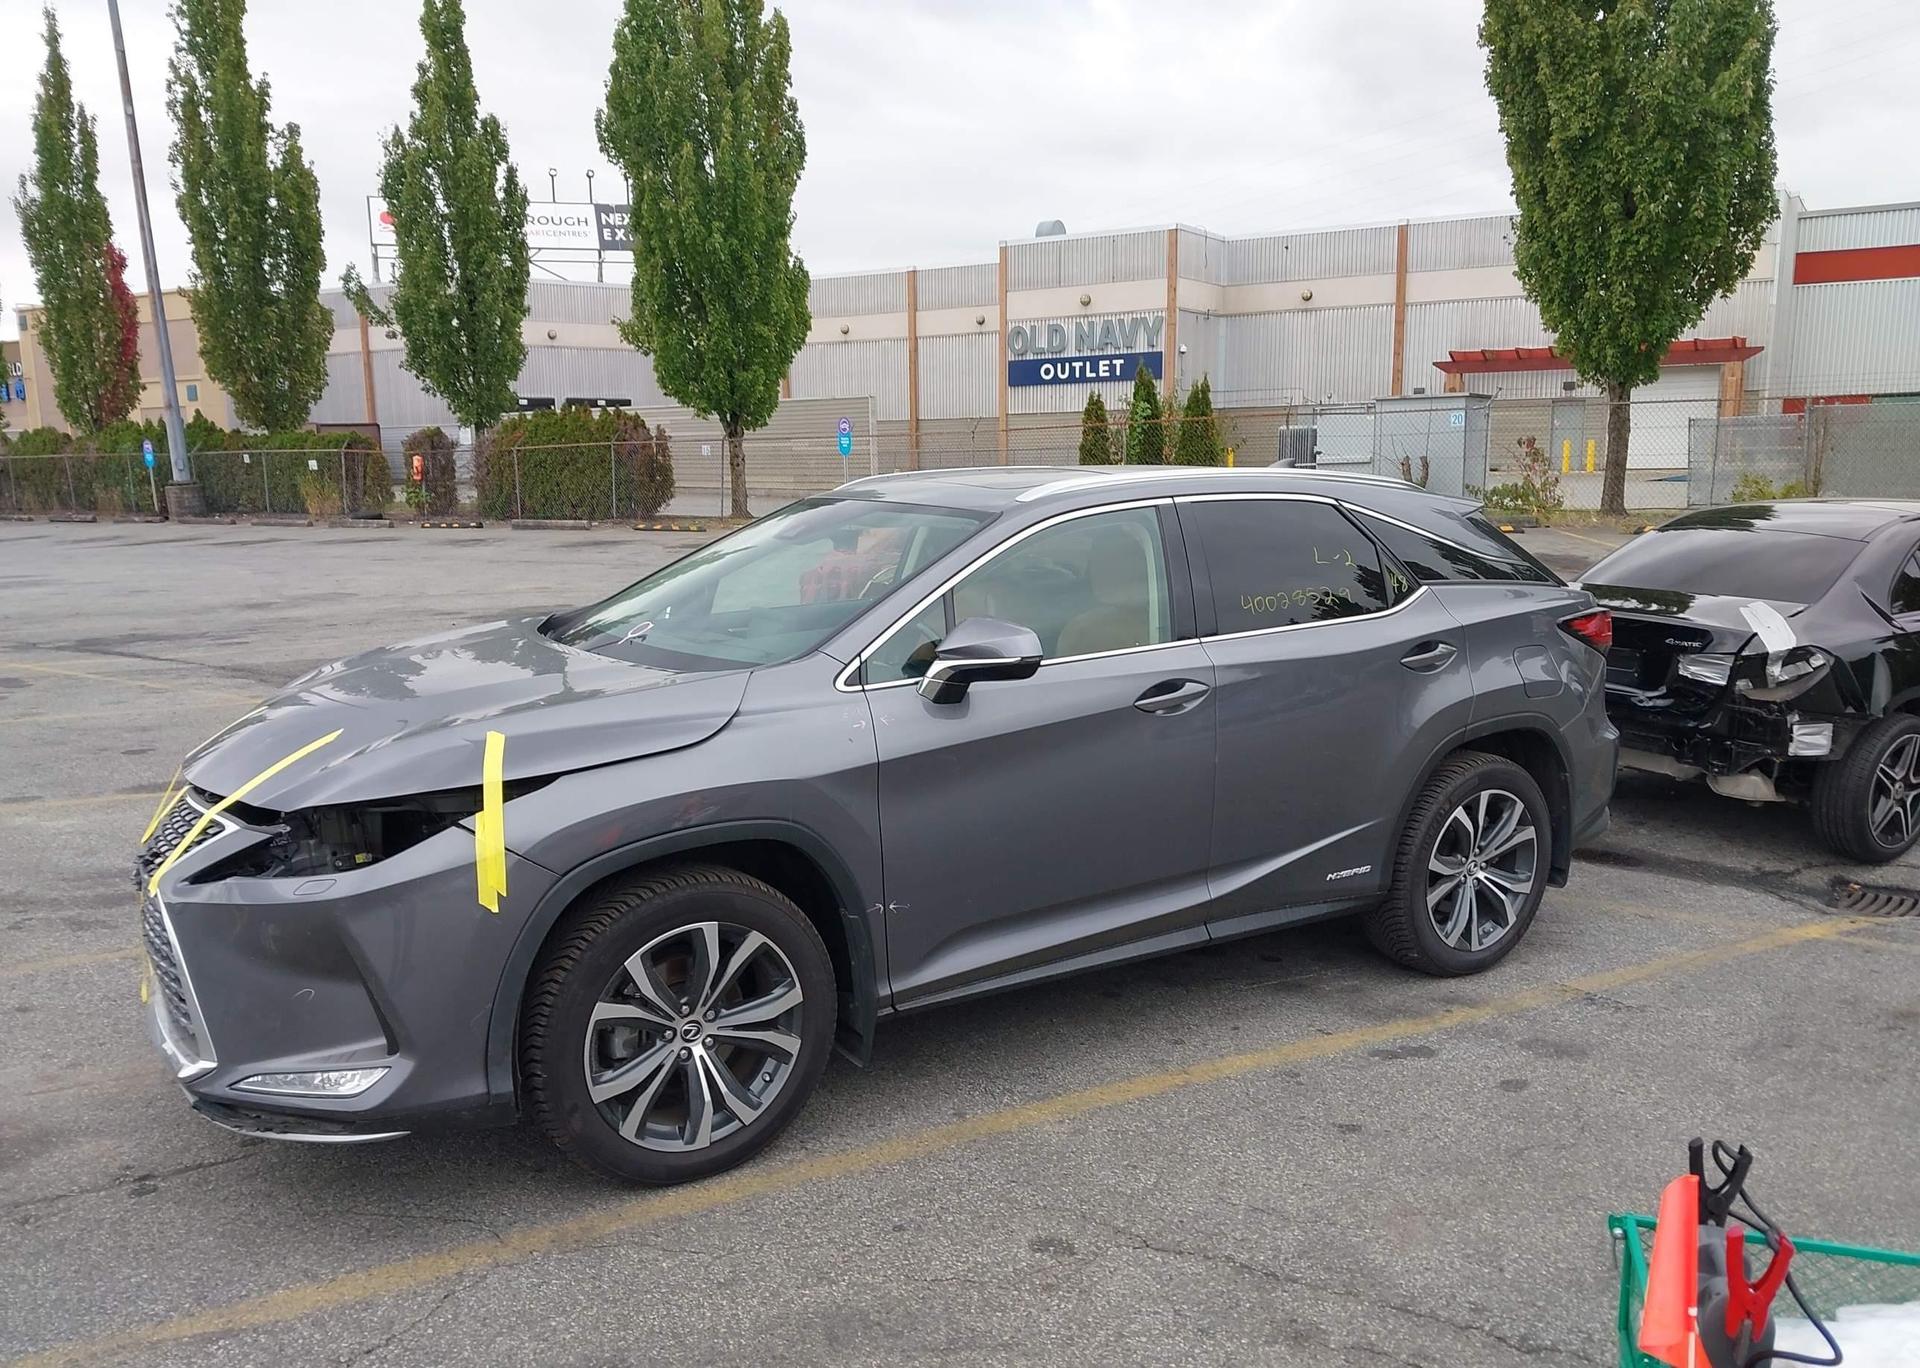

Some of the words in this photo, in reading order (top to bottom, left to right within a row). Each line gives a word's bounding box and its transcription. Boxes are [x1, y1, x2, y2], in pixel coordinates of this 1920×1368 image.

[1008, 322, 1067, 355] OLD
[1075, 315, 1163, 353] NAVY
[1040, 359, 1125, 380] OUTLET
[1452, 414, 1463, 425] 20
